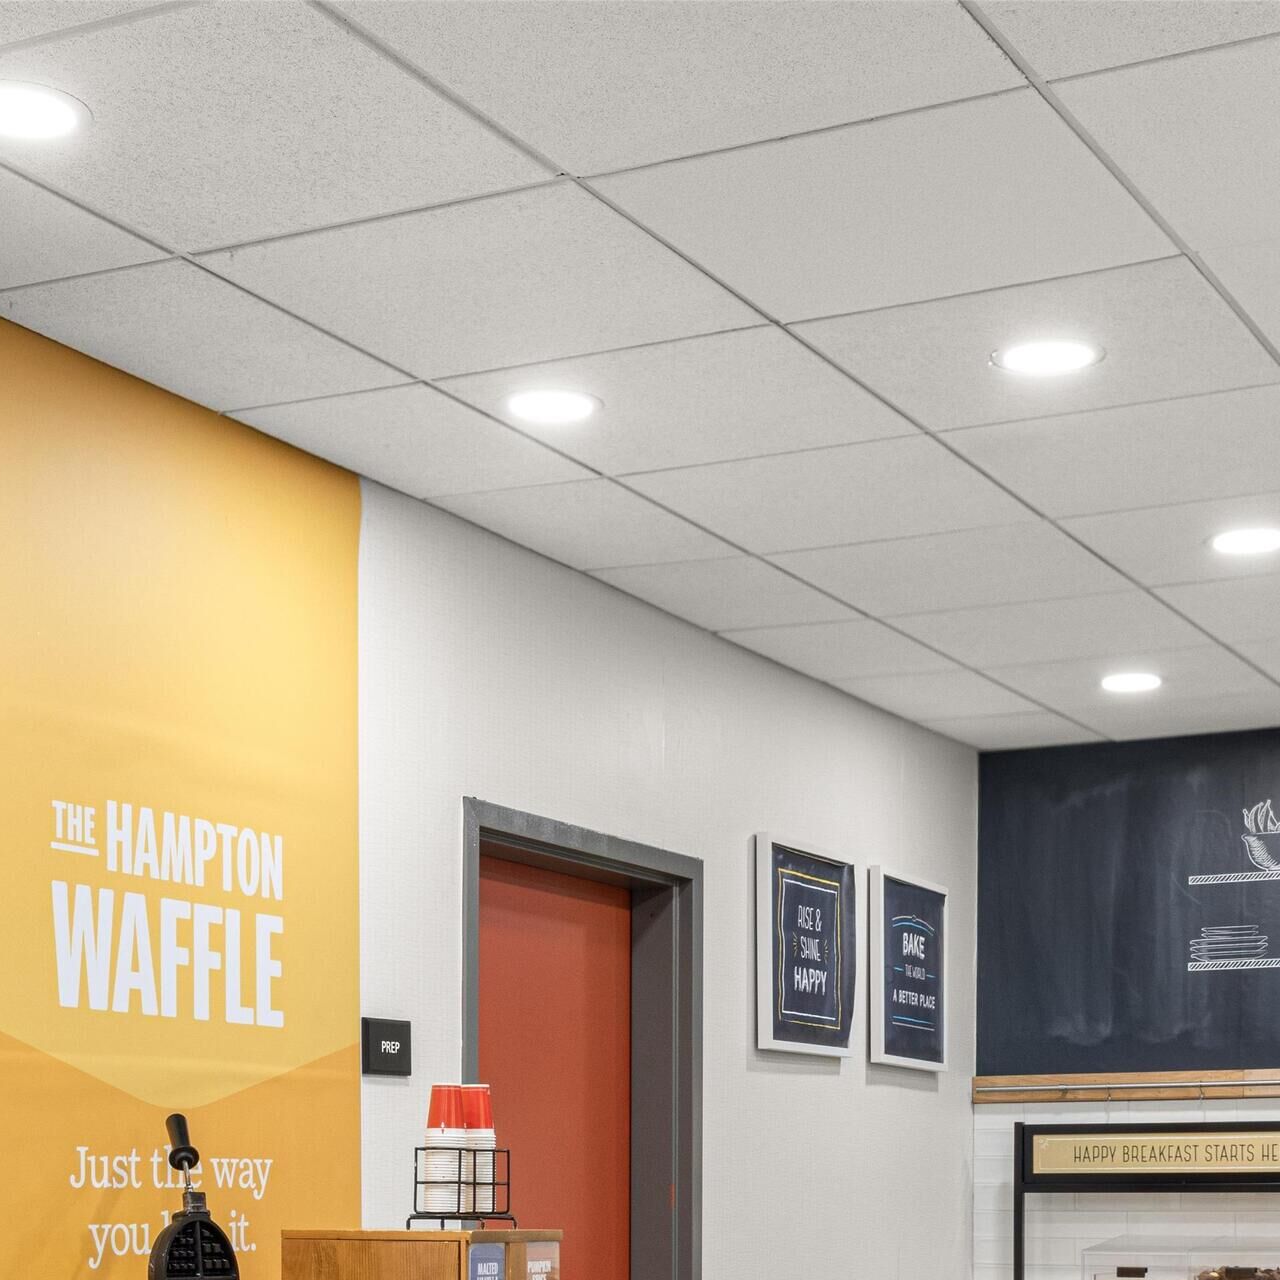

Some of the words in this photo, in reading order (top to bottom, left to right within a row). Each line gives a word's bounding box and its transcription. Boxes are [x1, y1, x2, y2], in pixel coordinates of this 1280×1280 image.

[51, 799, 96, 845] THE
[106, 800, 283, 901] HAMPTON
[797, 904, 814, 930] RISE
[815, 908, 823, 932] &
[51, 879, 284, 1028] WAFFLE
[800, 935, 822, 962] SHINE
[902, 932, 926, 960] BAKE
[794, 966, 827, 996] HAPPY
[904, 963, 912, 978] THE
[912, 966, 926, 980] WORLD
[892, 988, 898, 1003] A
[898, 989, 919, 1007] BETTER
[919, 993, 936, 1010] PLACE
[381, 1040, 400, 1054] PREP
[1073, 1145, 1117, 1163] HAPPY
[1122, 1144, 1200, 1162] BREAKFAST
[1204, 1144, 1255, 1162] STARTS
[70, 1146, 142, 1189] Just
[209, 1157, 273, 1200] way
[88, 1222, 152, 1269] you
[477, 1262, 499, 1275] MALTED
